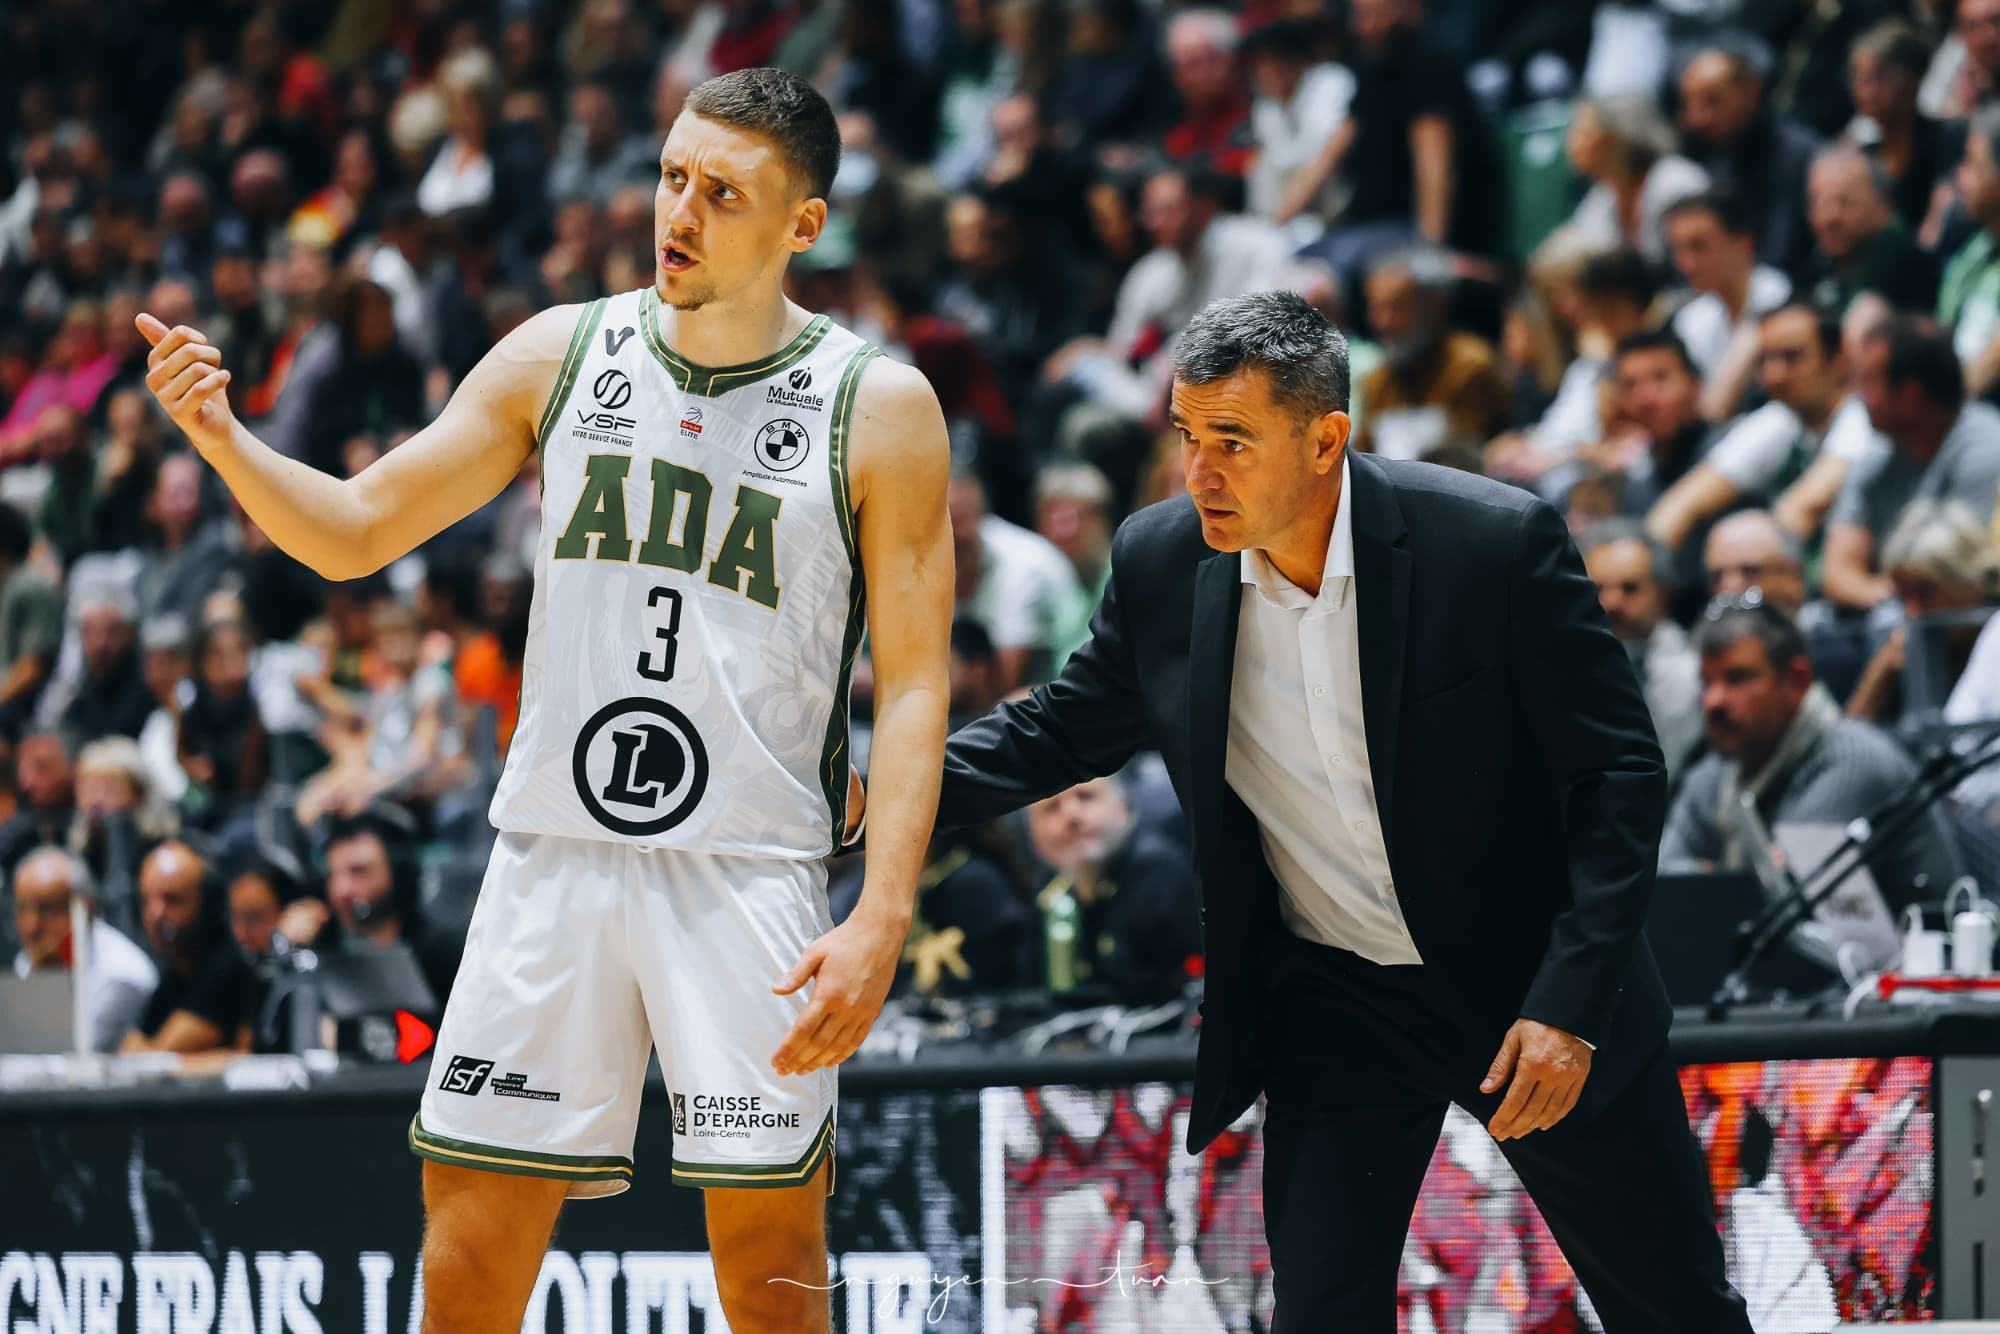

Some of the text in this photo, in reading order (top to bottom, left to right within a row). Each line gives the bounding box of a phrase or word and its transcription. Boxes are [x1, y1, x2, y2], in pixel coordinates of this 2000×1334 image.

[767, 385, 824, 407] Mutuale
[577, 409, 637, 431] VSF
[680, 429, 699, 440] ELITE
[766, 421, 805, 438] BMW
[588, 433, 611, 443] SERVICE
[610, 437, 633, 447] FRANCE
[742, 469, 772, 481] Amplitude
[553, 453, 784, 611] ADA
[637, 586, 683, 682] 3
[442, 1058, 492, 1092] isf
[693, 1095, 762, 1111] CAISSE
[693, 1112, 800, 1128] D'EPARGNE
[693, 1129, 751, 1139] Loire-Centre
